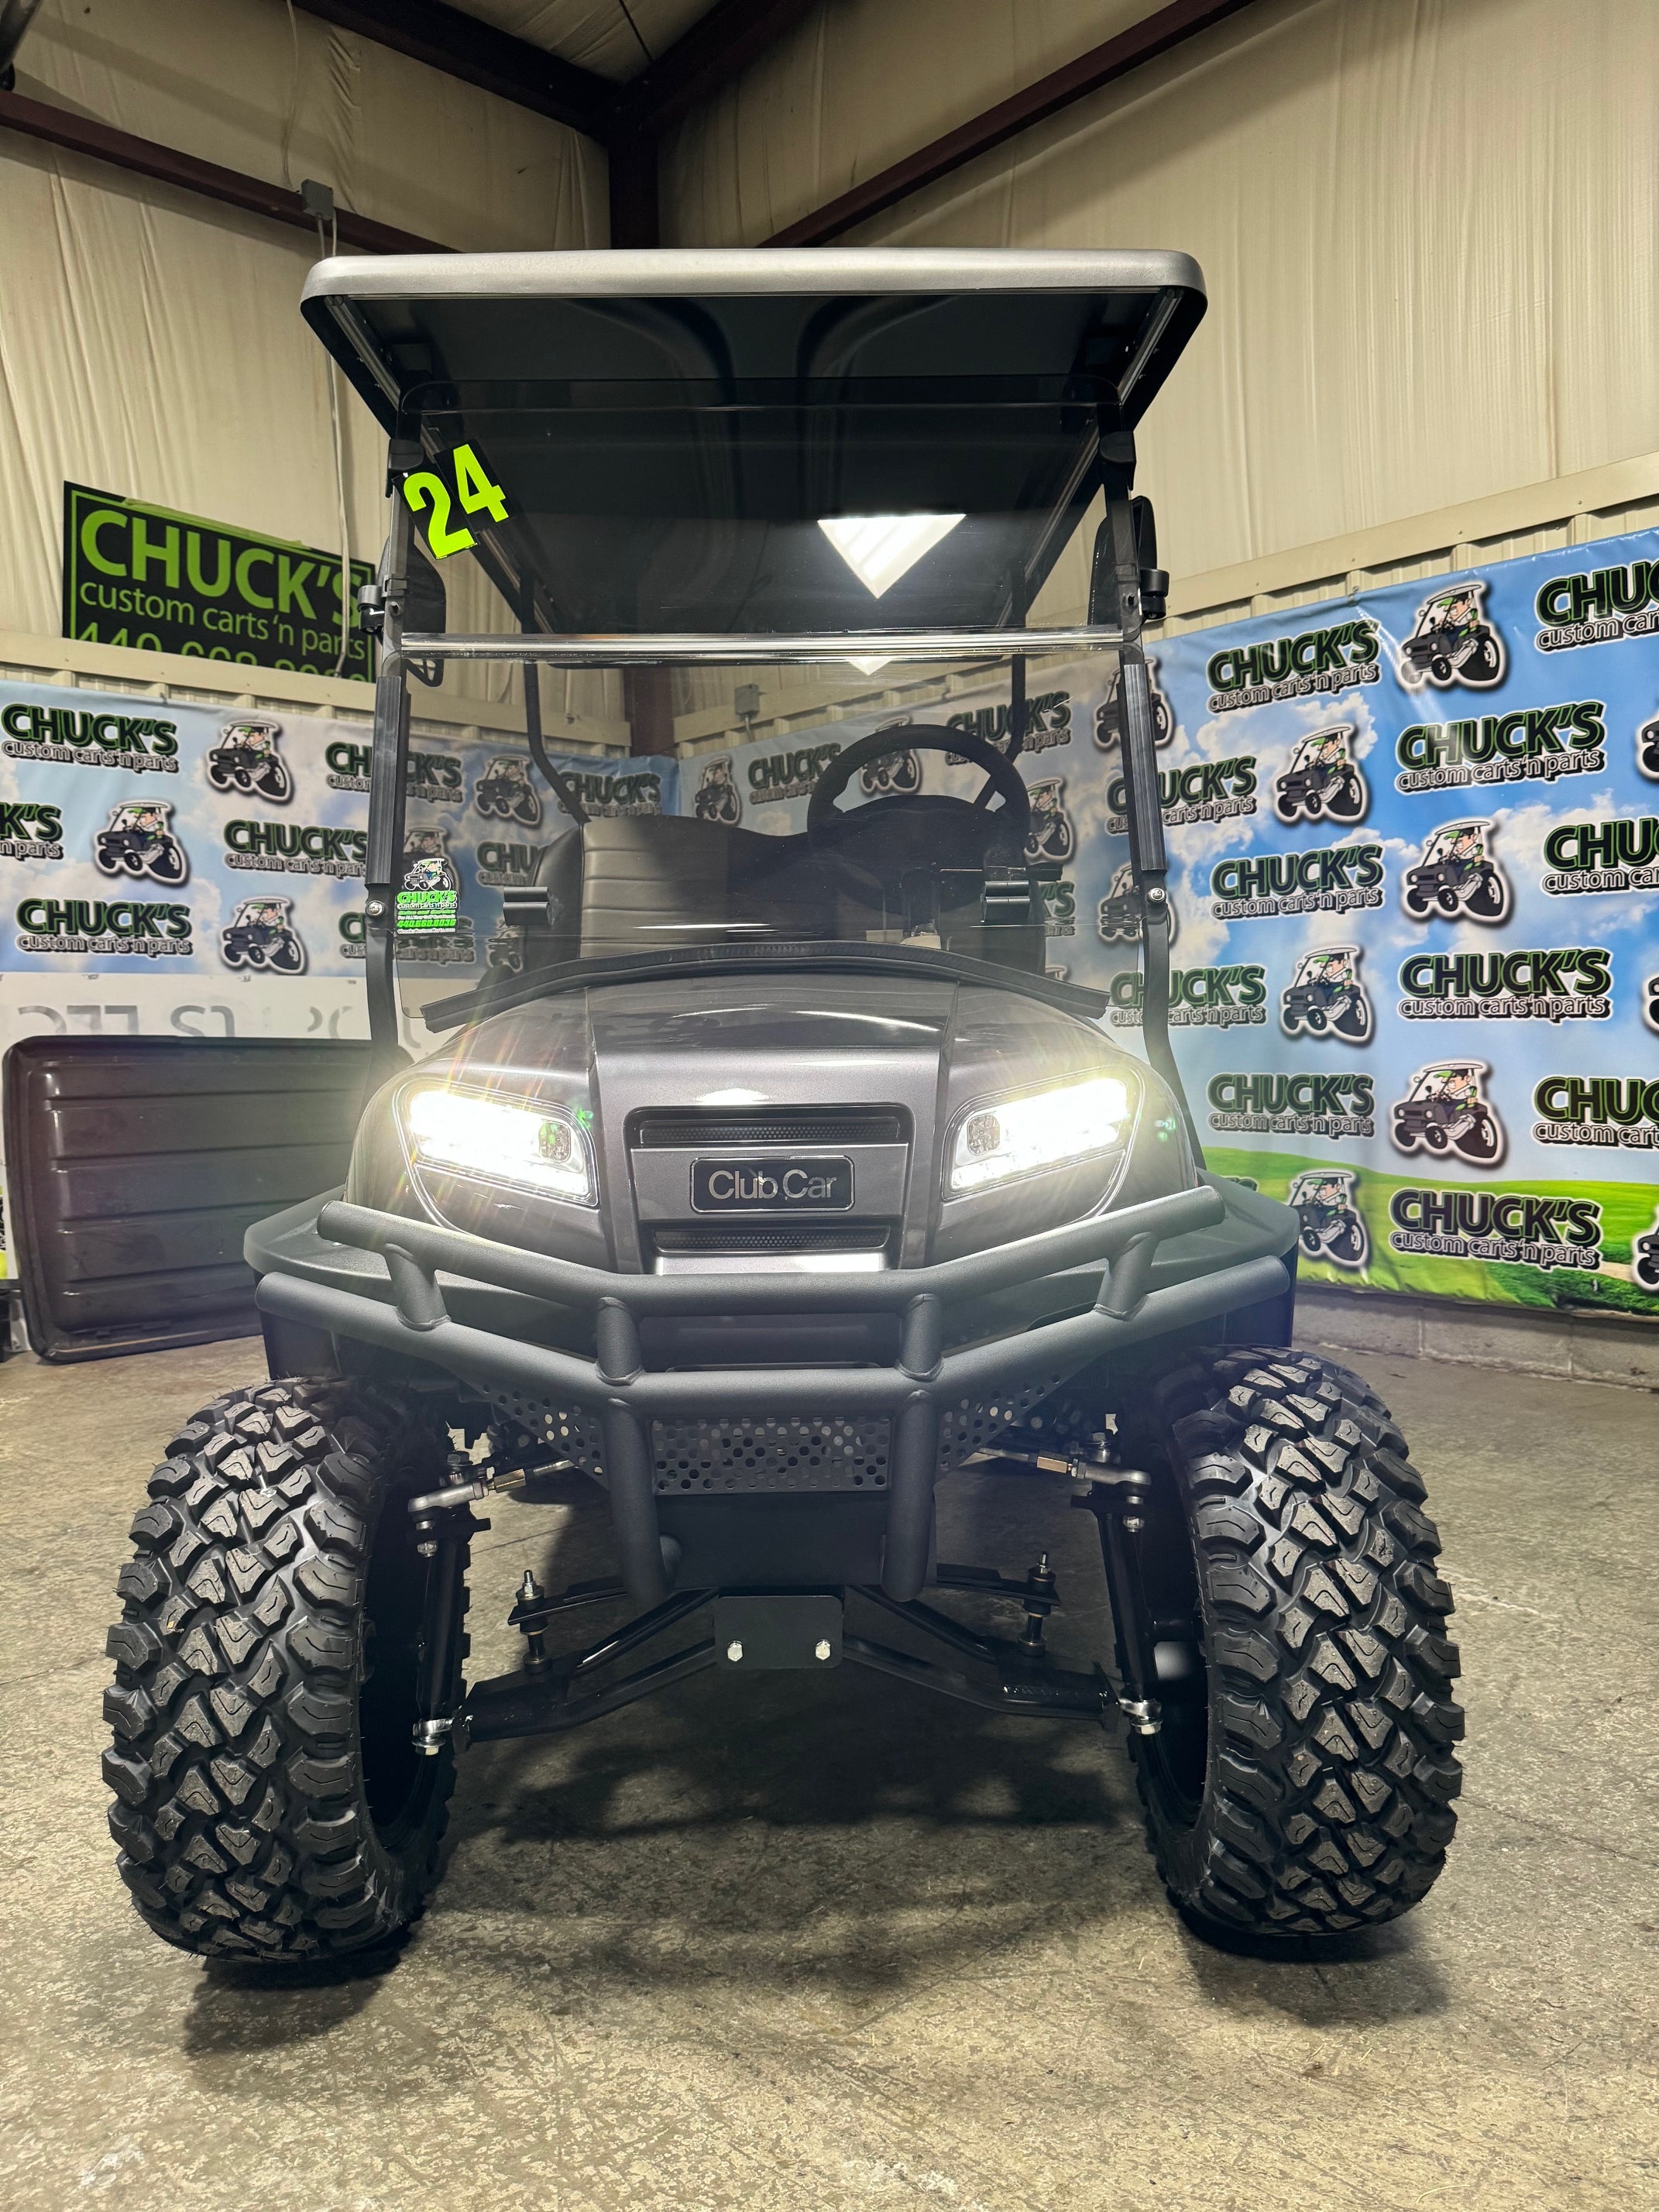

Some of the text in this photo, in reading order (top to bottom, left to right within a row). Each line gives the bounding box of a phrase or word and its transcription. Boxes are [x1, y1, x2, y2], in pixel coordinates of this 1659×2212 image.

[403, 444, 510, 559] 24
[81, 509, 362, 628] CHUCK'S
[80, 582, 194, 626] custom
[302, 629, 365, 660] parts
[1536, 610, 1659, 651] custom car
[1208, 620, 1379, 692] CHUCK'S
[1209, 687, 1272, 713] custom
[1331, 663, 1379, 695] parts
[1, 703, 178, 755] CHUCK'S
[1397, 702, 1605, 769] CHUCK'S
[2, 740, 73, 764] custom
[132, 754, 179, 773] parts
[1396, 768, 1471, 793] custom
[1544, 749, 1605, 782] parts
[1213, 795, 1257, 823] parts
[15, 840, 64, 861] parts
[225, 853, 284, 872] custom
[1544, 818, 1659, 872] CHU
[1211, 844, 1383, 900] CHUCK'S
[1542, 869, 1630, 895] custom
[397, 891, 457, 904] CHUCK'S
[1212, 898, 1276, 919] custom
[1335, 886, 1382, 914] parts
[16, 898, 192, 938] CHUCK'S
[17, 935, 88, 952] custom
[146, 938, 193, 957] parts
[1400, 950, 1611, 998] CHUCK'S
[1220, 1005, 1266, 1029] parts
[1398, 997, 1479, 1019] custom
[1549, 995, 1611, 1023] parts
[1207, 1073, 1374, 1117] CHUCK'S
[1208, 1112, 1269, 1133] custom
[1328, 1115, 1374, 1140] parts
[1533, 1122, 1619, 1147] custom
[708, 1169, 837, 1200] Club Car
[1390, 1189, 1601, 1247] CHUCK'S
[1390, 1231, 1468, 1258] custom
[1540, 1242, 1602, 1270] parts
